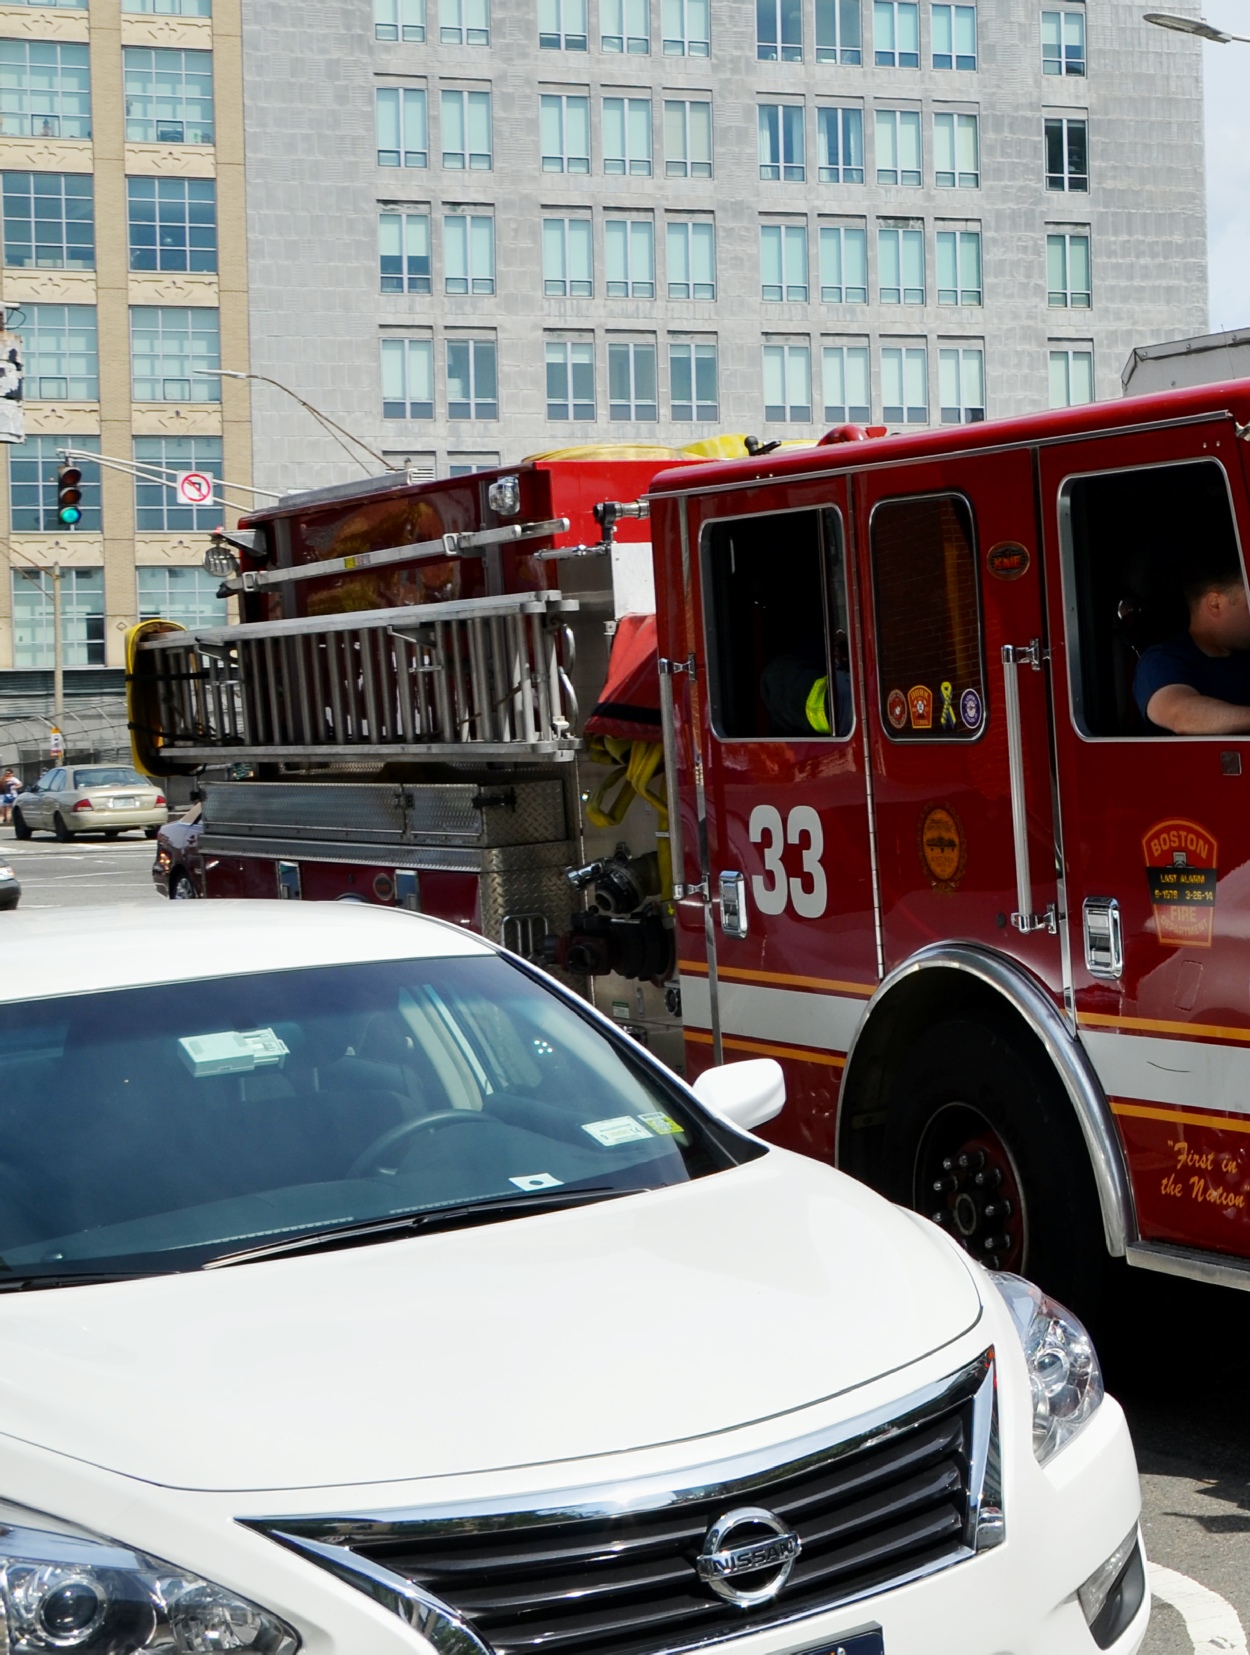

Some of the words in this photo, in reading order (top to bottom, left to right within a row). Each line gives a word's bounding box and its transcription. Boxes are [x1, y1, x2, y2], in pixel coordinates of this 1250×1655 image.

[1150, 830, 1209, 860] BOSTON
[749, 804, 828, 918] 33
[1160, 874, 1178, 883] LAST
[1180, 874, 1205, 884] ALARM
[1170, 904, 1198, 922] FIRE
[1160, 915, 1208, 937] DEPARTMENT
[1221, 1154, 1238, 1174] in
[1161, 1172, 1183, 1197] the
[712, 1539, 797, 1577] NISSAN
